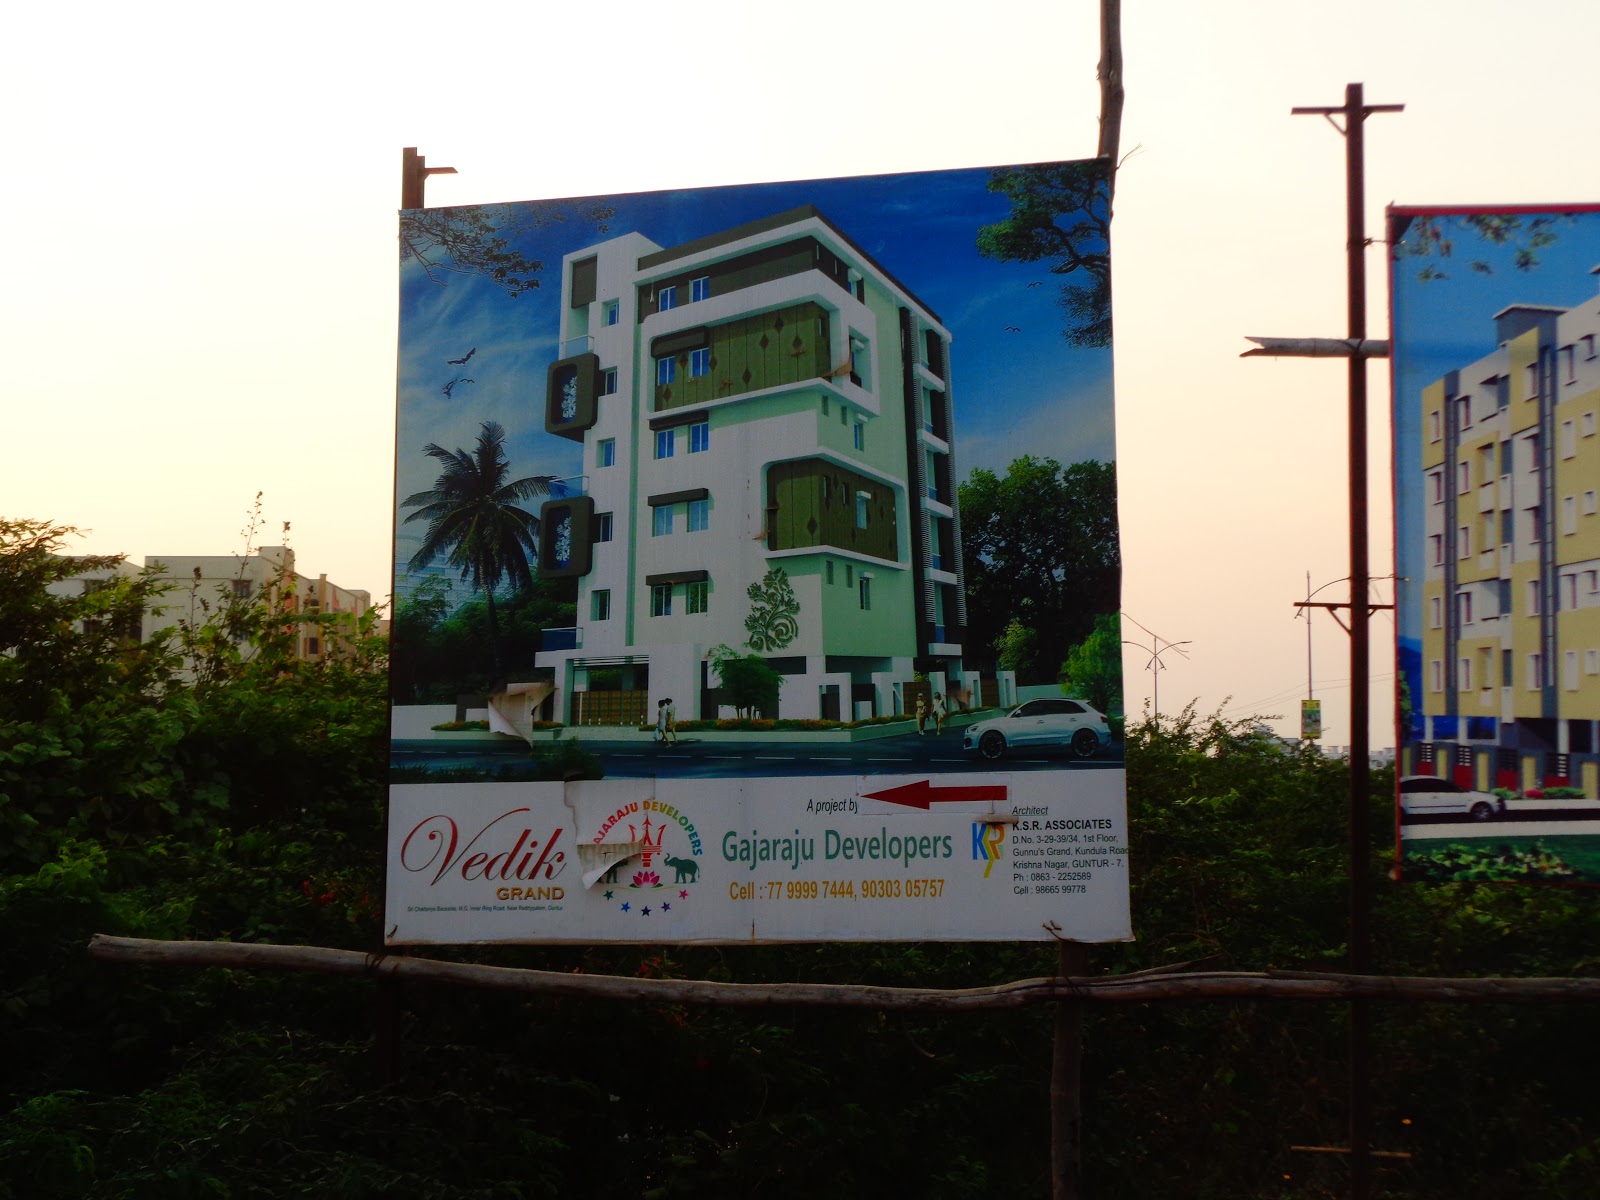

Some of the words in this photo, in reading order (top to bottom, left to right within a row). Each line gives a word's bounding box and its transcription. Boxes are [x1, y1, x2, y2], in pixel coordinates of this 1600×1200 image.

[807, 798, 814, 812] A
[815, 798, 847, 815] project
[1012, 806, 1048, 816] Architect
[593, 801, 639, 844] AJARAJU
[643, 800, 702, 856] DEVELOPERS
[1012, 821, 1042, 831] K.S.R.
[1045, 819, 1112, 830] ASSOCIATES
[1083, 834, 1095, 842] 1st
[1097, 833, 1119, 843] Floor,
[400, 807, 567, 886] Vedik
[722, 830, 814, 870] Gajaraju
[825, 827, 952, 867] Developers
[1013, 847, 1045, 857] Gunnu's
[1046, 846, 1073, 857] Grand,
[1013, 860, 1042, 869] Krishna
[1044, 860, 1070, 871] Nagar,
[1072, 859, 1109, 868] GUNTUR
[1013, 873, 1024, 882] Ph
[1030, 873, 1050, 882] 0863
[1057, 872, 1092, 881] 2252589
[496, 886, 565, 900] GRAND
[729, 881, 755, 900] Cell
[767, 881, 783, 899] 77
[787, 881, 818, 899] 9999
[822, 880, 857, 901] 7444,
[862, 880, 901, 898] 90303
[905, 879, 945, 898] 05757
[1013, 886, 1029, 895] Cell
[1035, 885, 1060, 894] 98665
[1061, 885, 1087, 894] 99778
